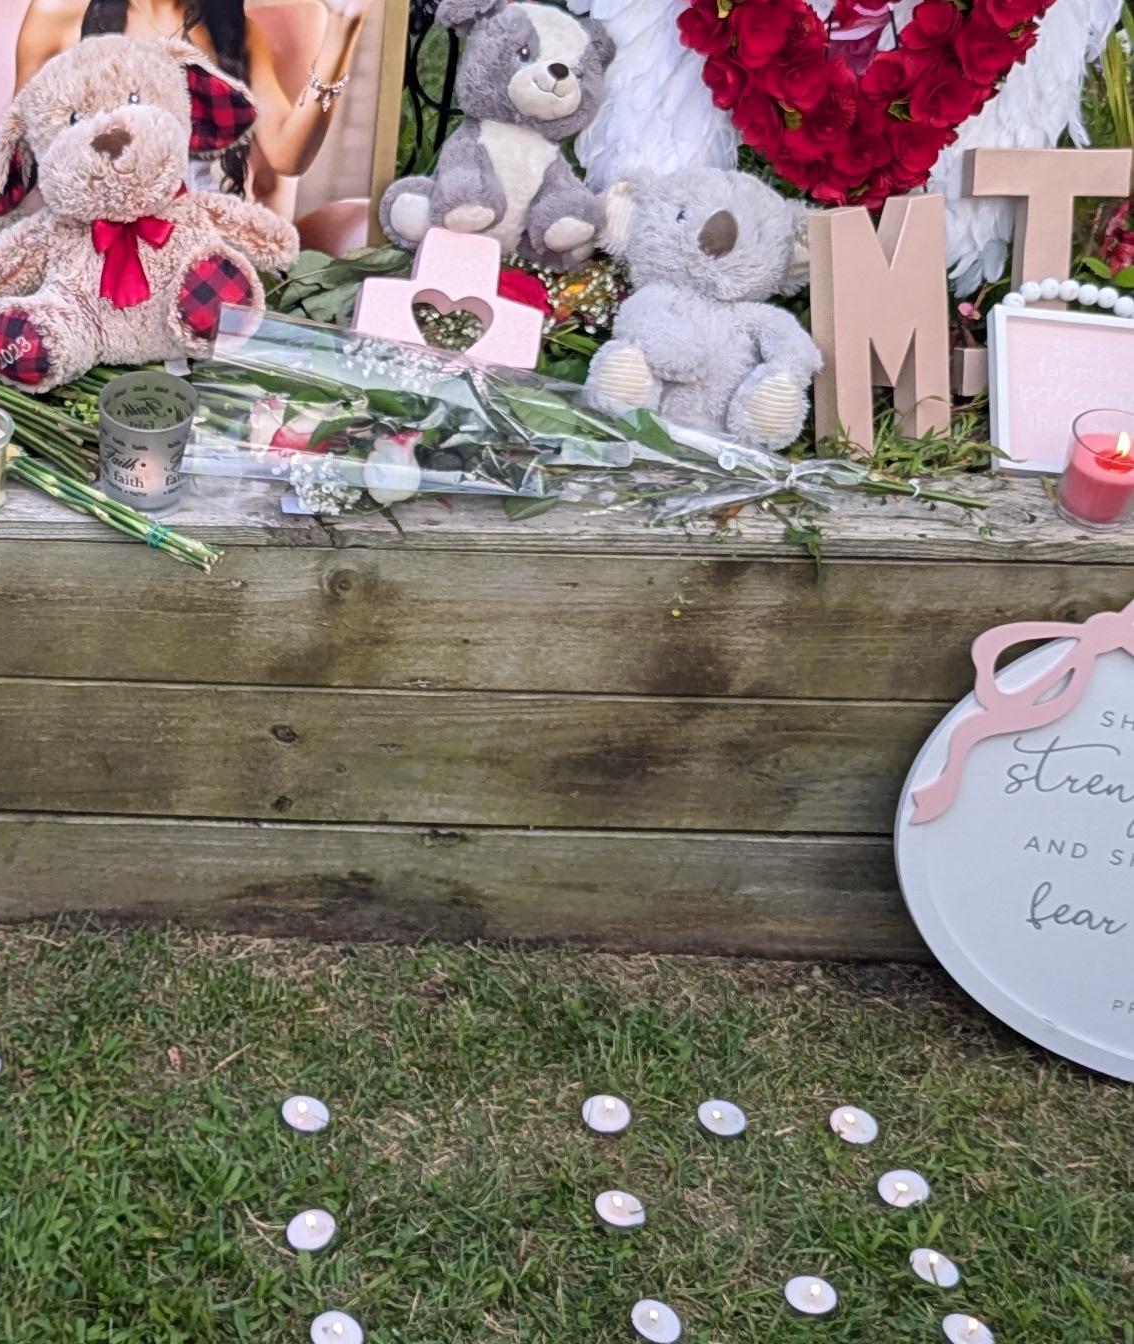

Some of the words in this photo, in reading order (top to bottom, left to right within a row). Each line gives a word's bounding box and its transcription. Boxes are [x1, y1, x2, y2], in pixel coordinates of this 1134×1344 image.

[105, 443, 140, 471] Faith
[114, 471, 145, 488] faith
[1005, 735, 1134, 805] stren
[1024, 836, 1088, 859] AND
[1109, 849, 1134, 868] S
